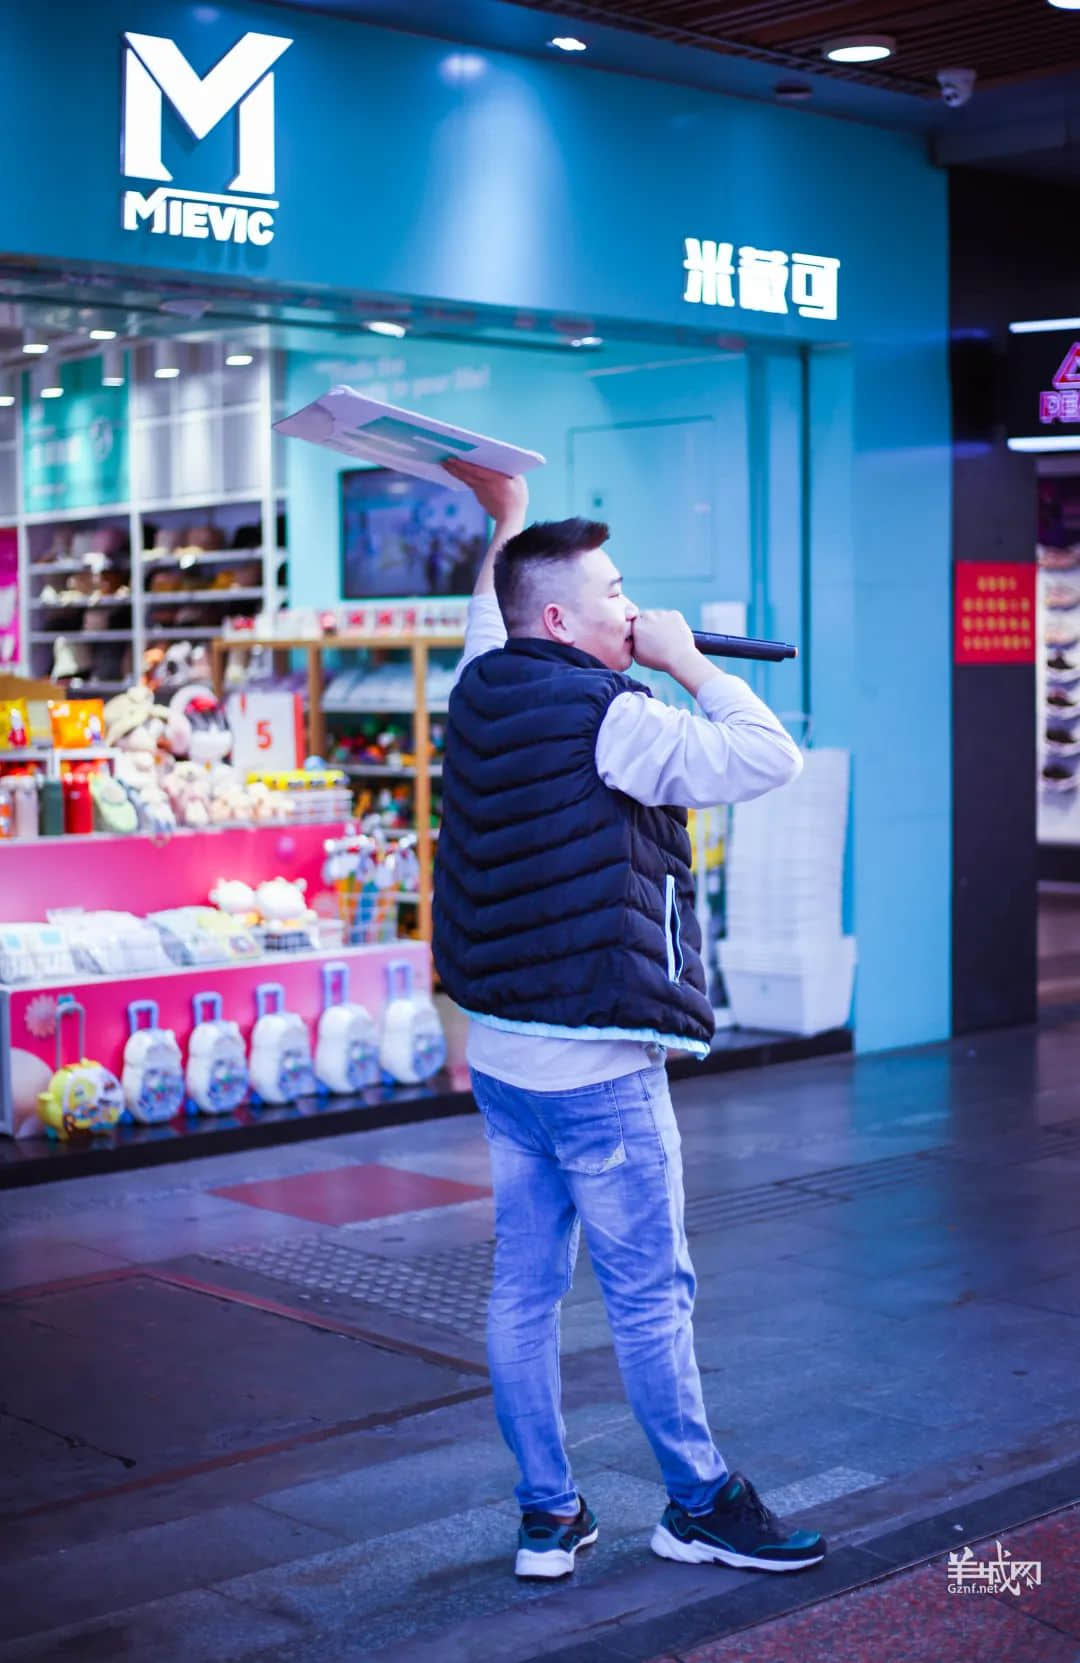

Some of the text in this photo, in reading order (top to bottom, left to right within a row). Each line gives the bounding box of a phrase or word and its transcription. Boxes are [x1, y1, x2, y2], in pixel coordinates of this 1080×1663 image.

[122, 31, 294, 195] M
[123, 187, 279, 246] MIEVIC
[256, 720, 273, 750] 5
